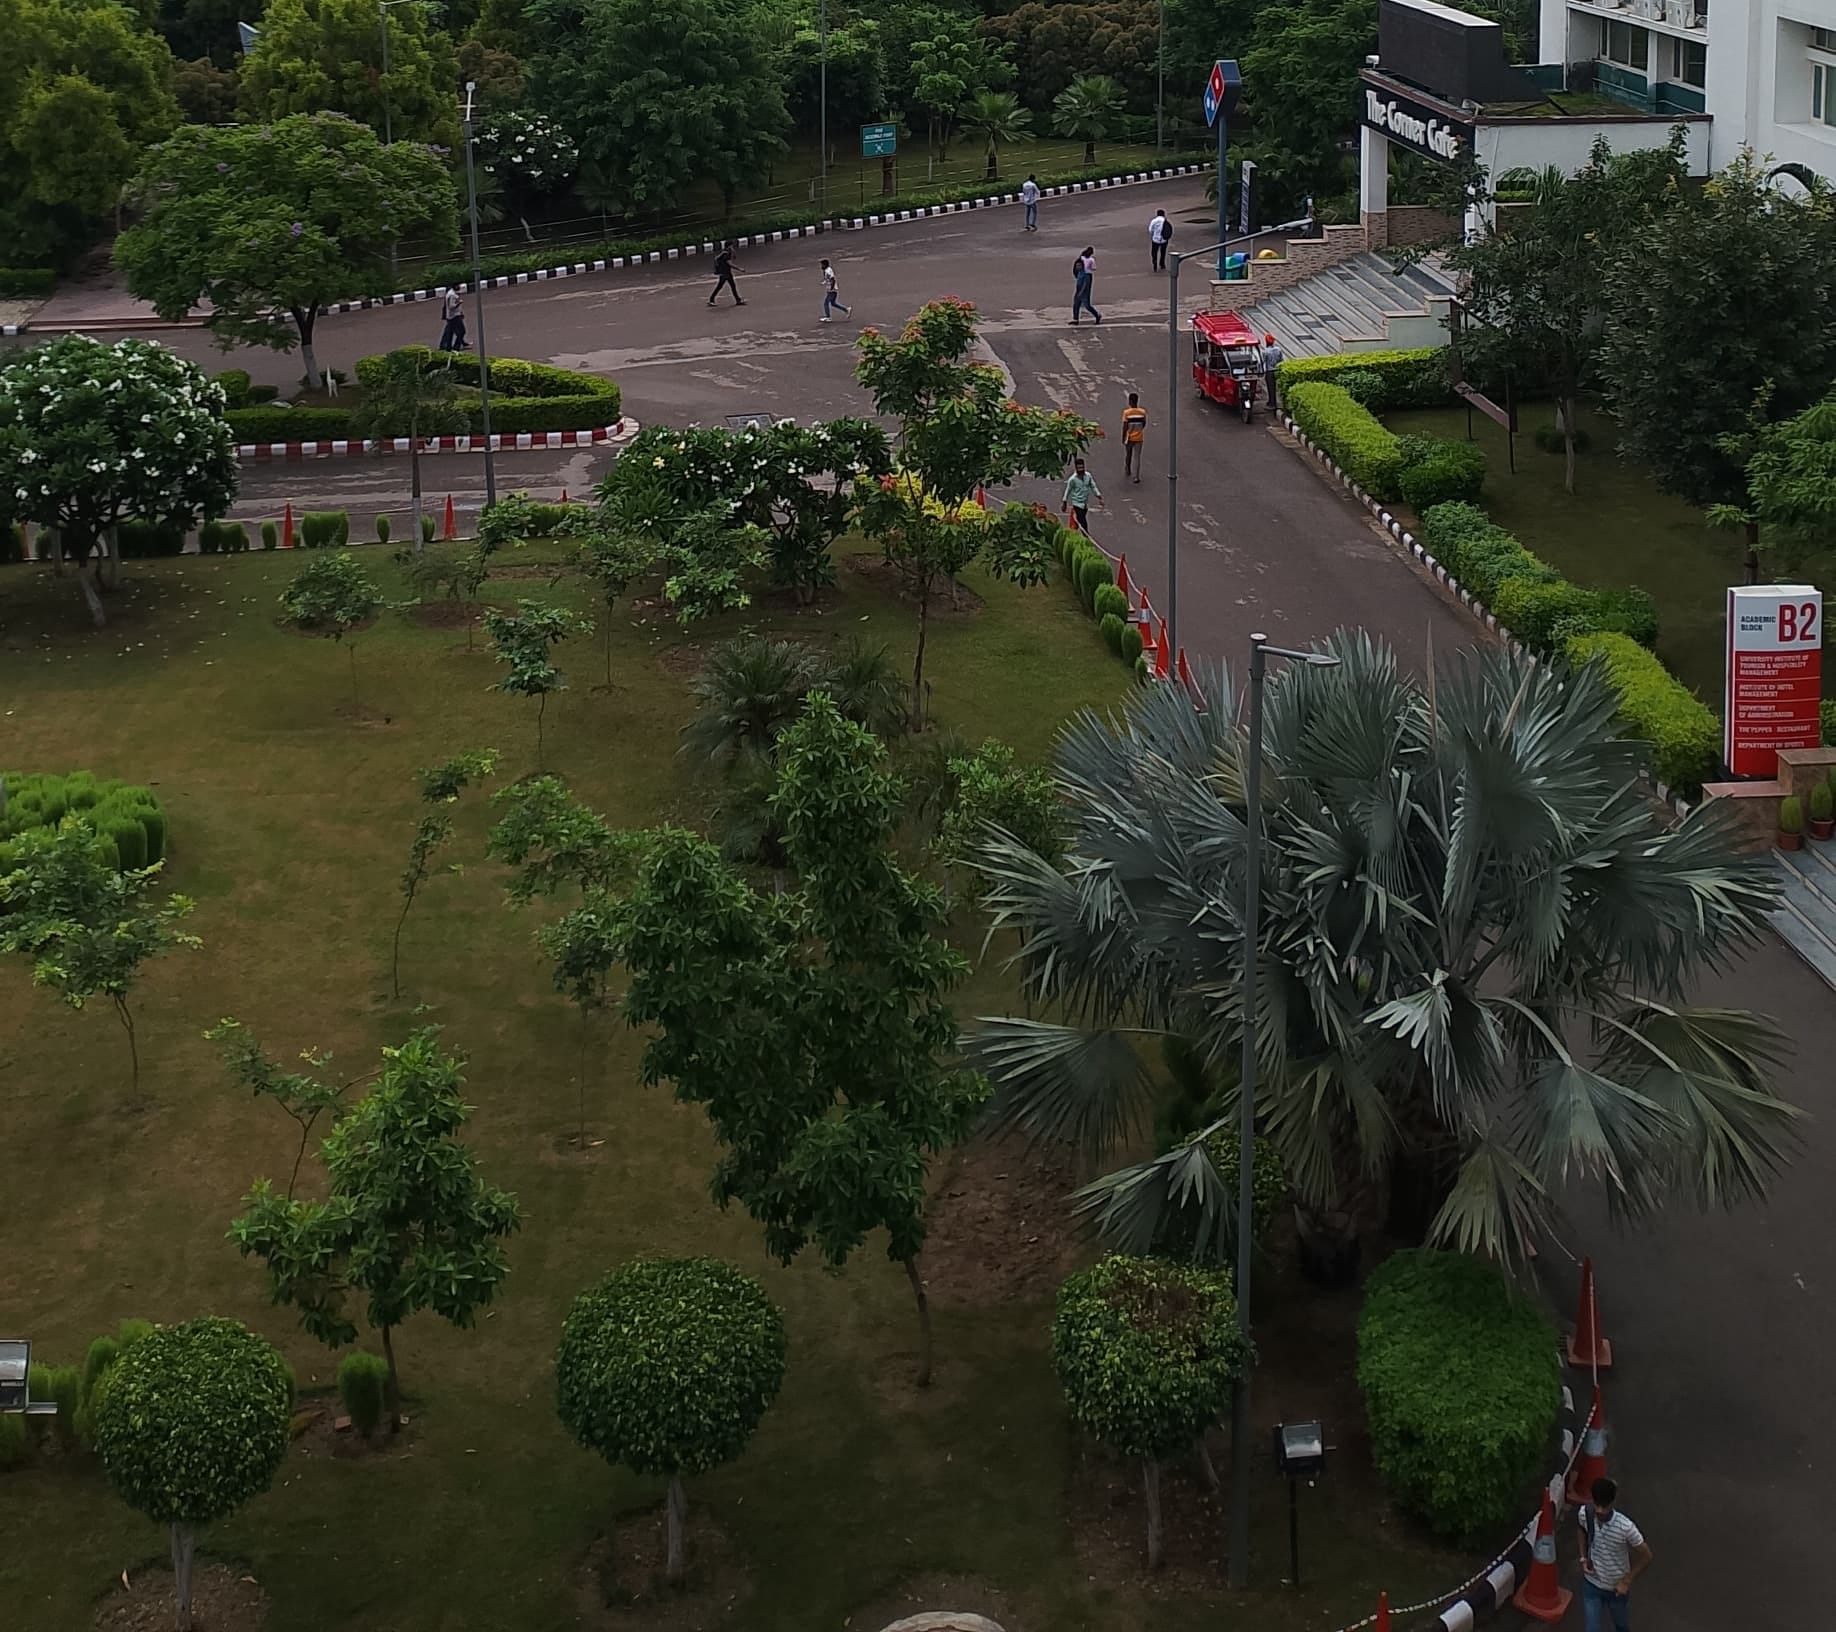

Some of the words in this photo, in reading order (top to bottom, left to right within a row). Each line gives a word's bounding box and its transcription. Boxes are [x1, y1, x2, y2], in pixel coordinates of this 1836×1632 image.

[1366, 89, 1387, 127] The
[1387, 100, 1426, 146] Corner
[1740, 615, 1776, 624] ACADEMIC
[1740, 623, 1763, 632] BLOCK
[1778, 602, 1817, 643] B2
